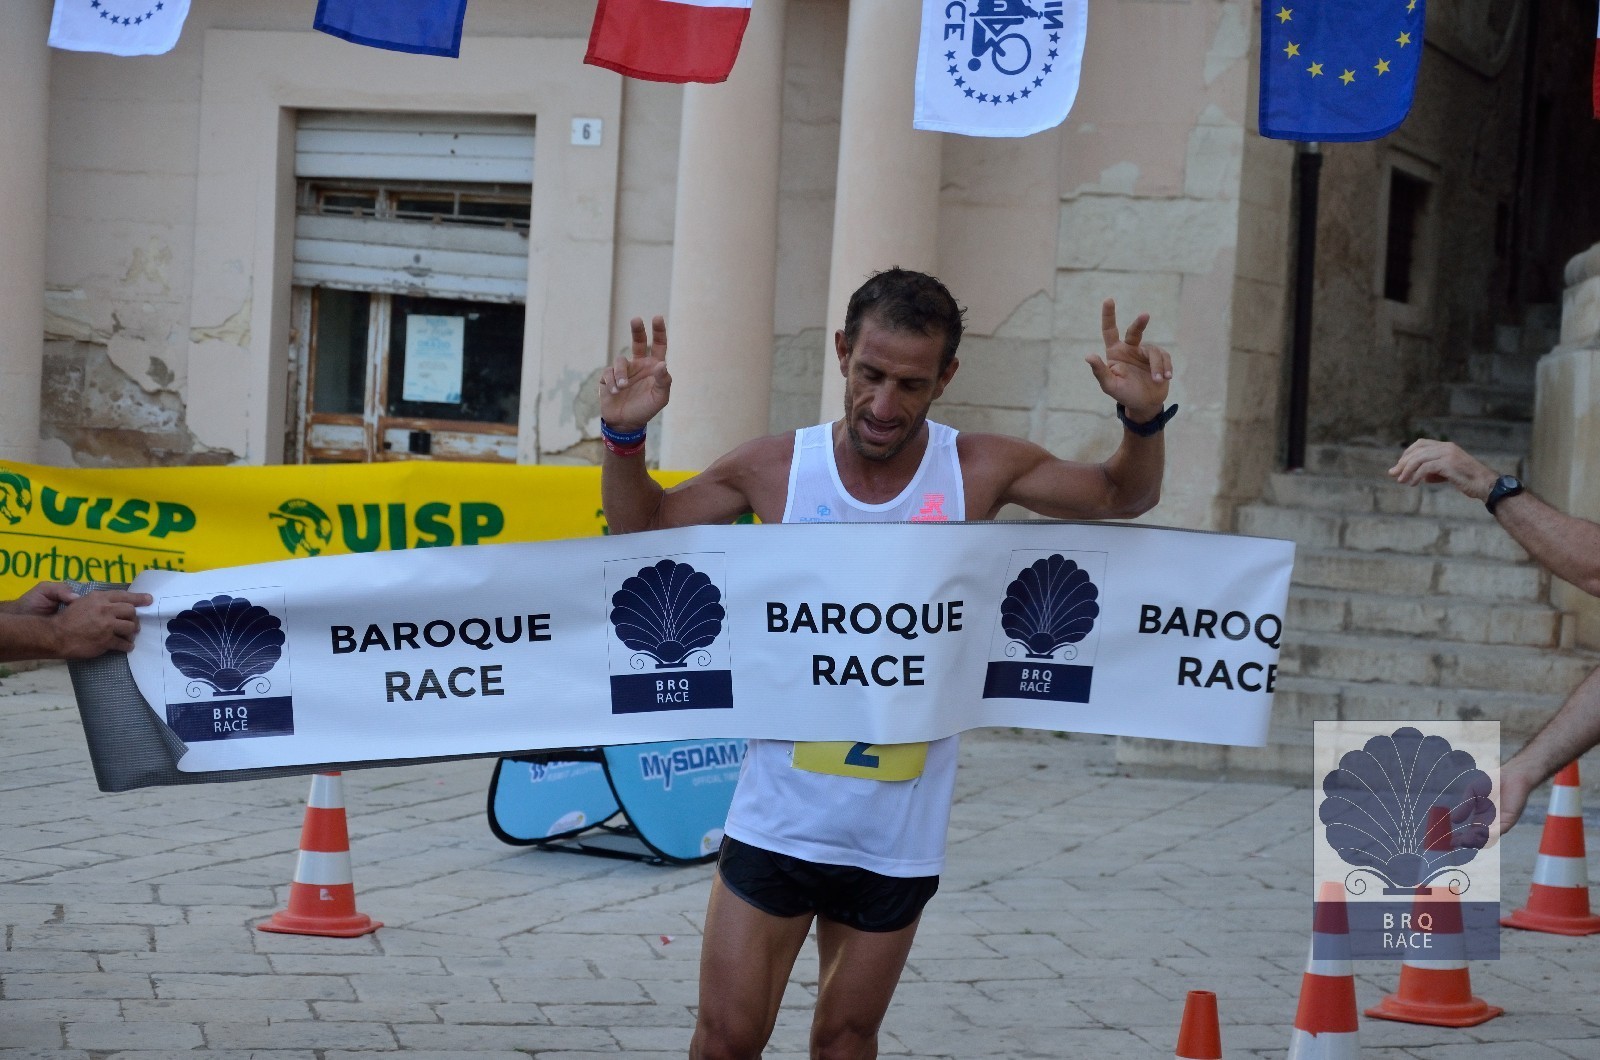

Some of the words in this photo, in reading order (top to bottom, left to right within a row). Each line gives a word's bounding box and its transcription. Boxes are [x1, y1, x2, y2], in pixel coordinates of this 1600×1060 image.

[582, 123, 591, 140] 6
[40, 486, 197, 539] UISP
[337, 502, 505, 552] UISP
[331, 613, 552, 655] BAROQUE
[766, 601, 964, 640] BAROQUE
[1138, 604, 1282, 649] BAROQ
[385, 665, 505, 703] RACE
[656, 678, 689, 692] BRQ
[812, 655, 925, 687] RACE
[1021, 668, 1053, 682] BRQ
[656, 691, 690, 704] RACE
[1019, 682, 1051, 693] RACE
[213, 706, 248, 721] BRQ
[214, 720, 248, 733] RACE
[641, 744, 739, 788] MySDAM
